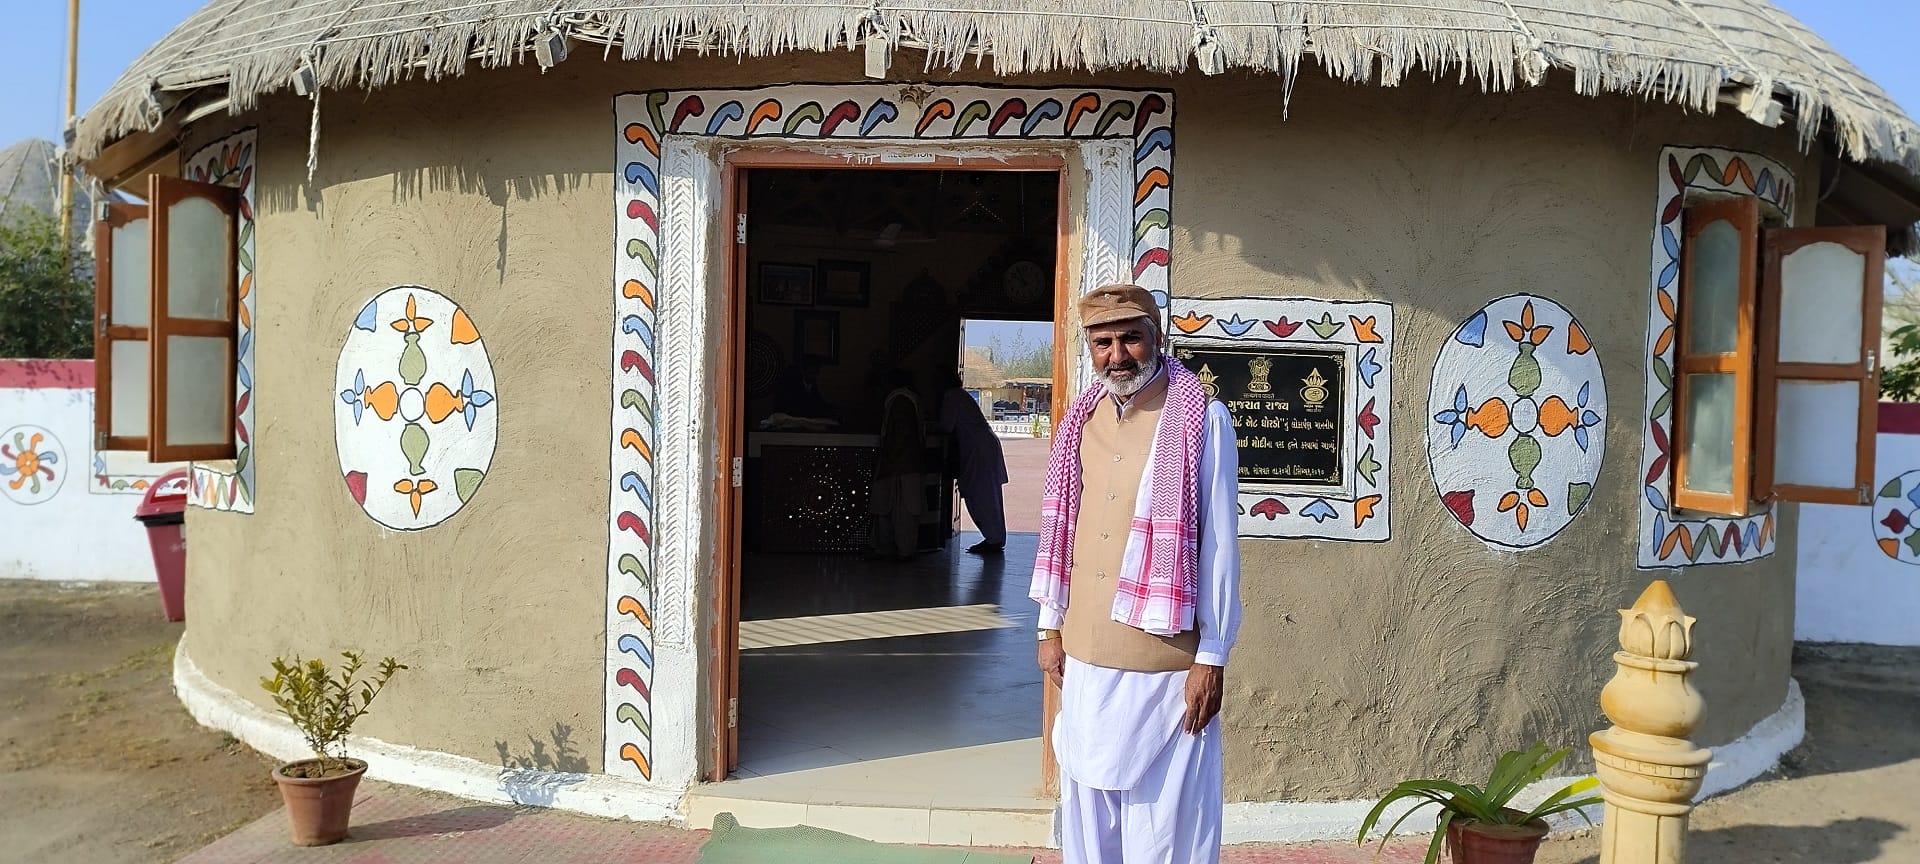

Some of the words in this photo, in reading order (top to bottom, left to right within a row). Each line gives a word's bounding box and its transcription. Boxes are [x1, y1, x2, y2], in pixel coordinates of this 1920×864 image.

[1227, 400, 1260, 413] ગુજરાત
[1265, 401, 1289, 411] રાજ્ય
[1245, 415, 1258, 428] એટ
